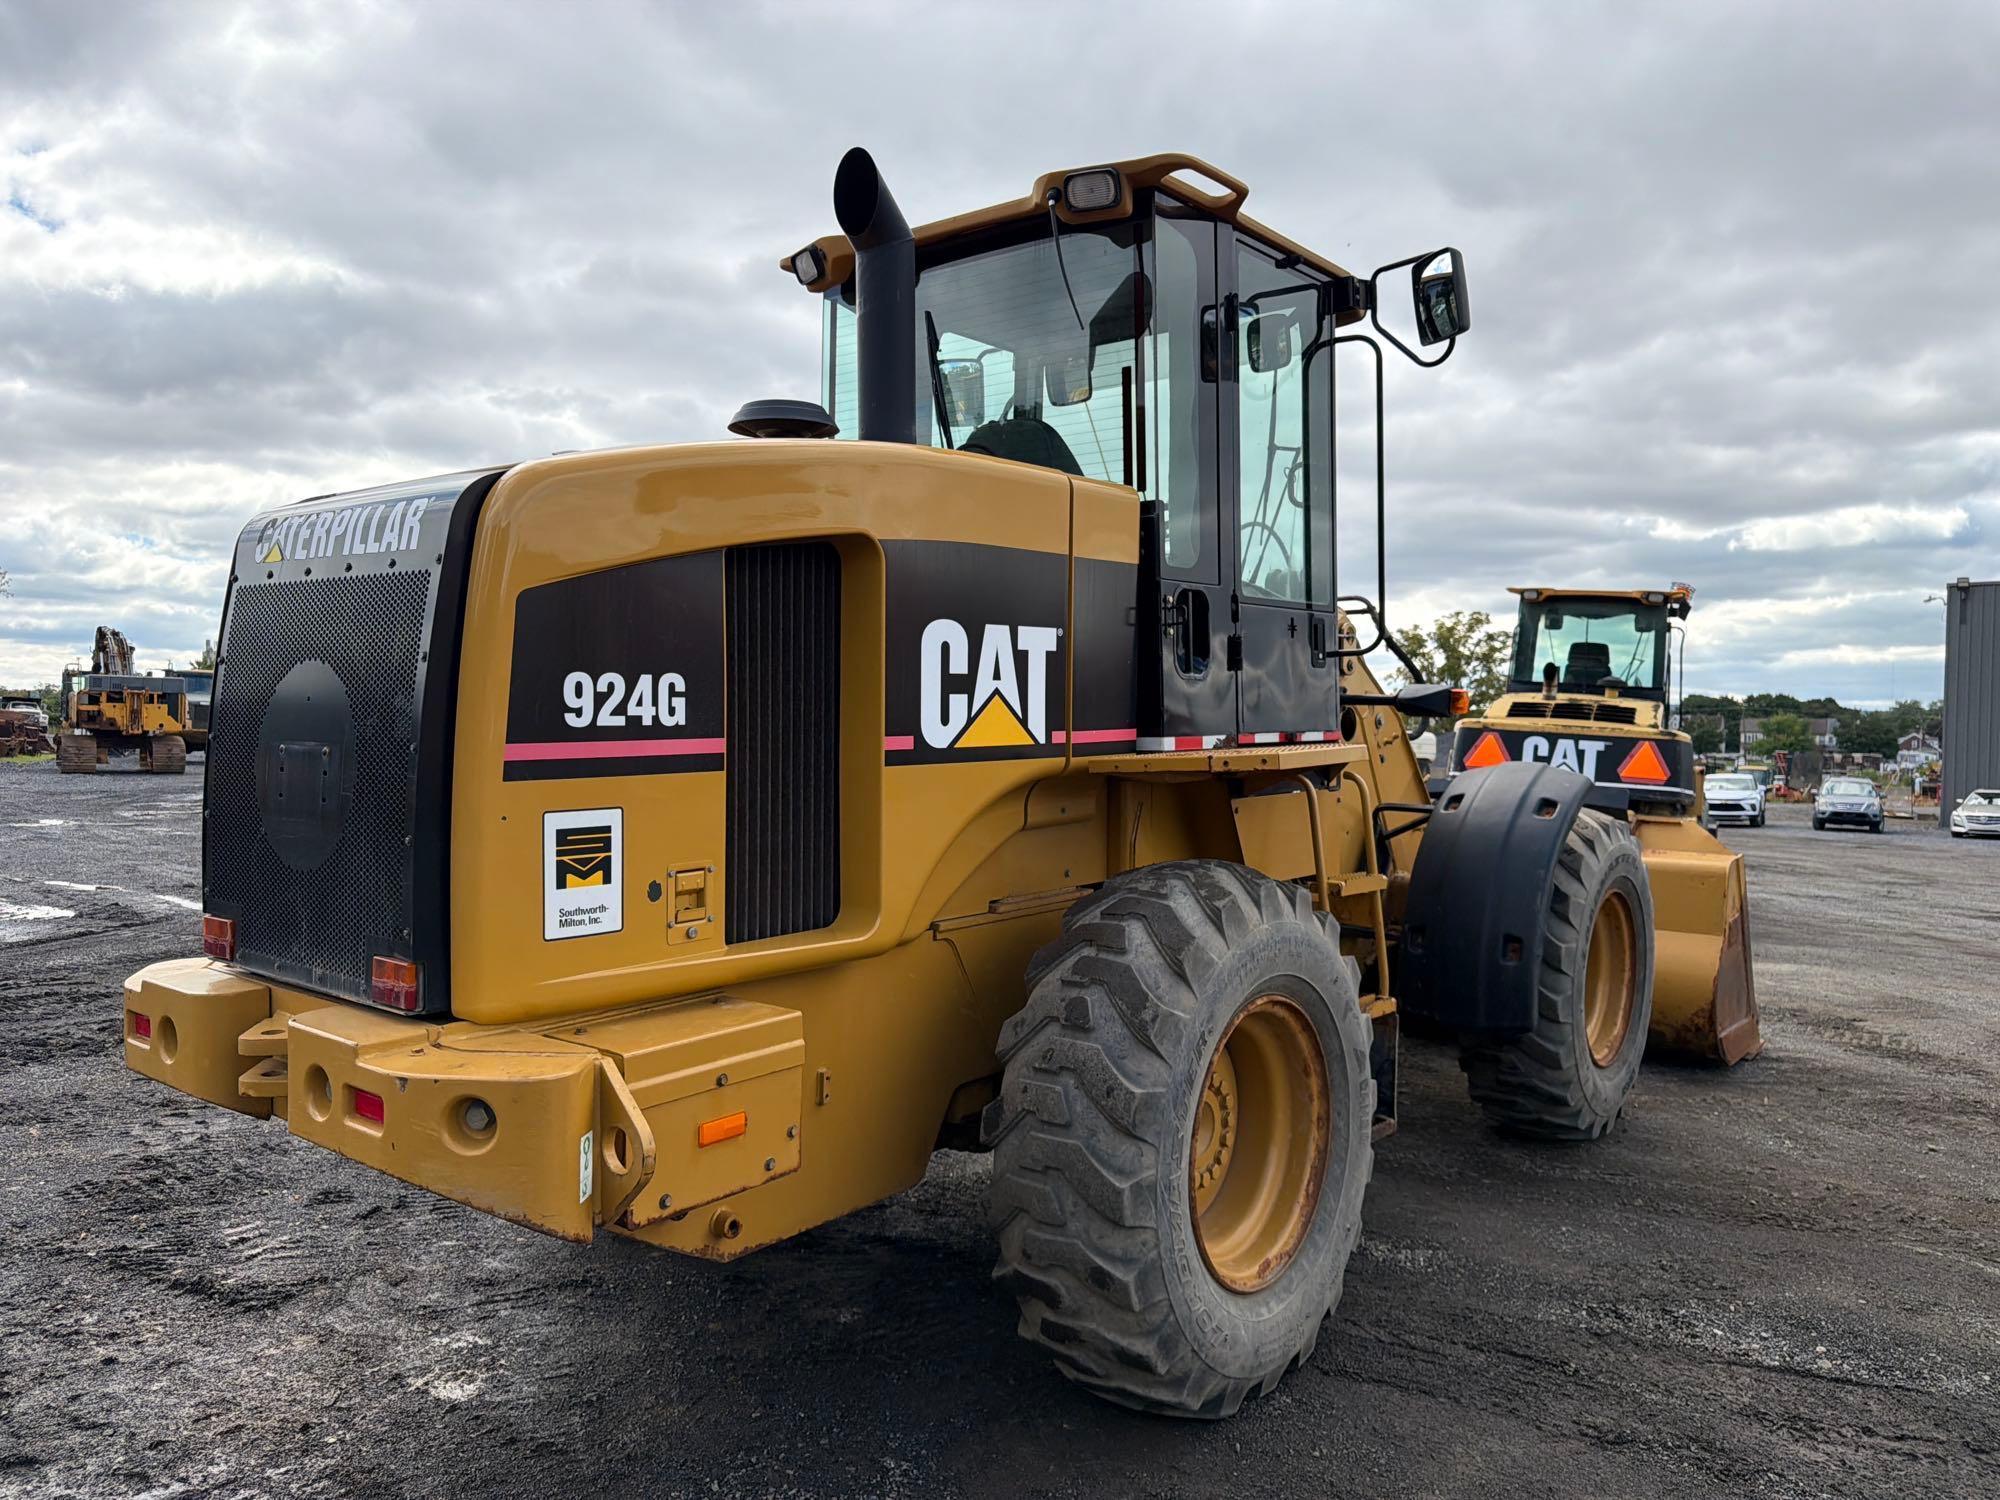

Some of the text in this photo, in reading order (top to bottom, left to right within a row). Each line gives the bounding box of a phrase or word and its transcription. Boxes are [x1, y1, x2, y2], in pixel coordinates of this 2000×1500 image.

[255, 497, 429, 564] CATERPILLAR
[563, 671, 686, 728] 924G
[558, 904, 609, 918] Southworth-
[559, 916, 602, 928] Milton, Inc.
